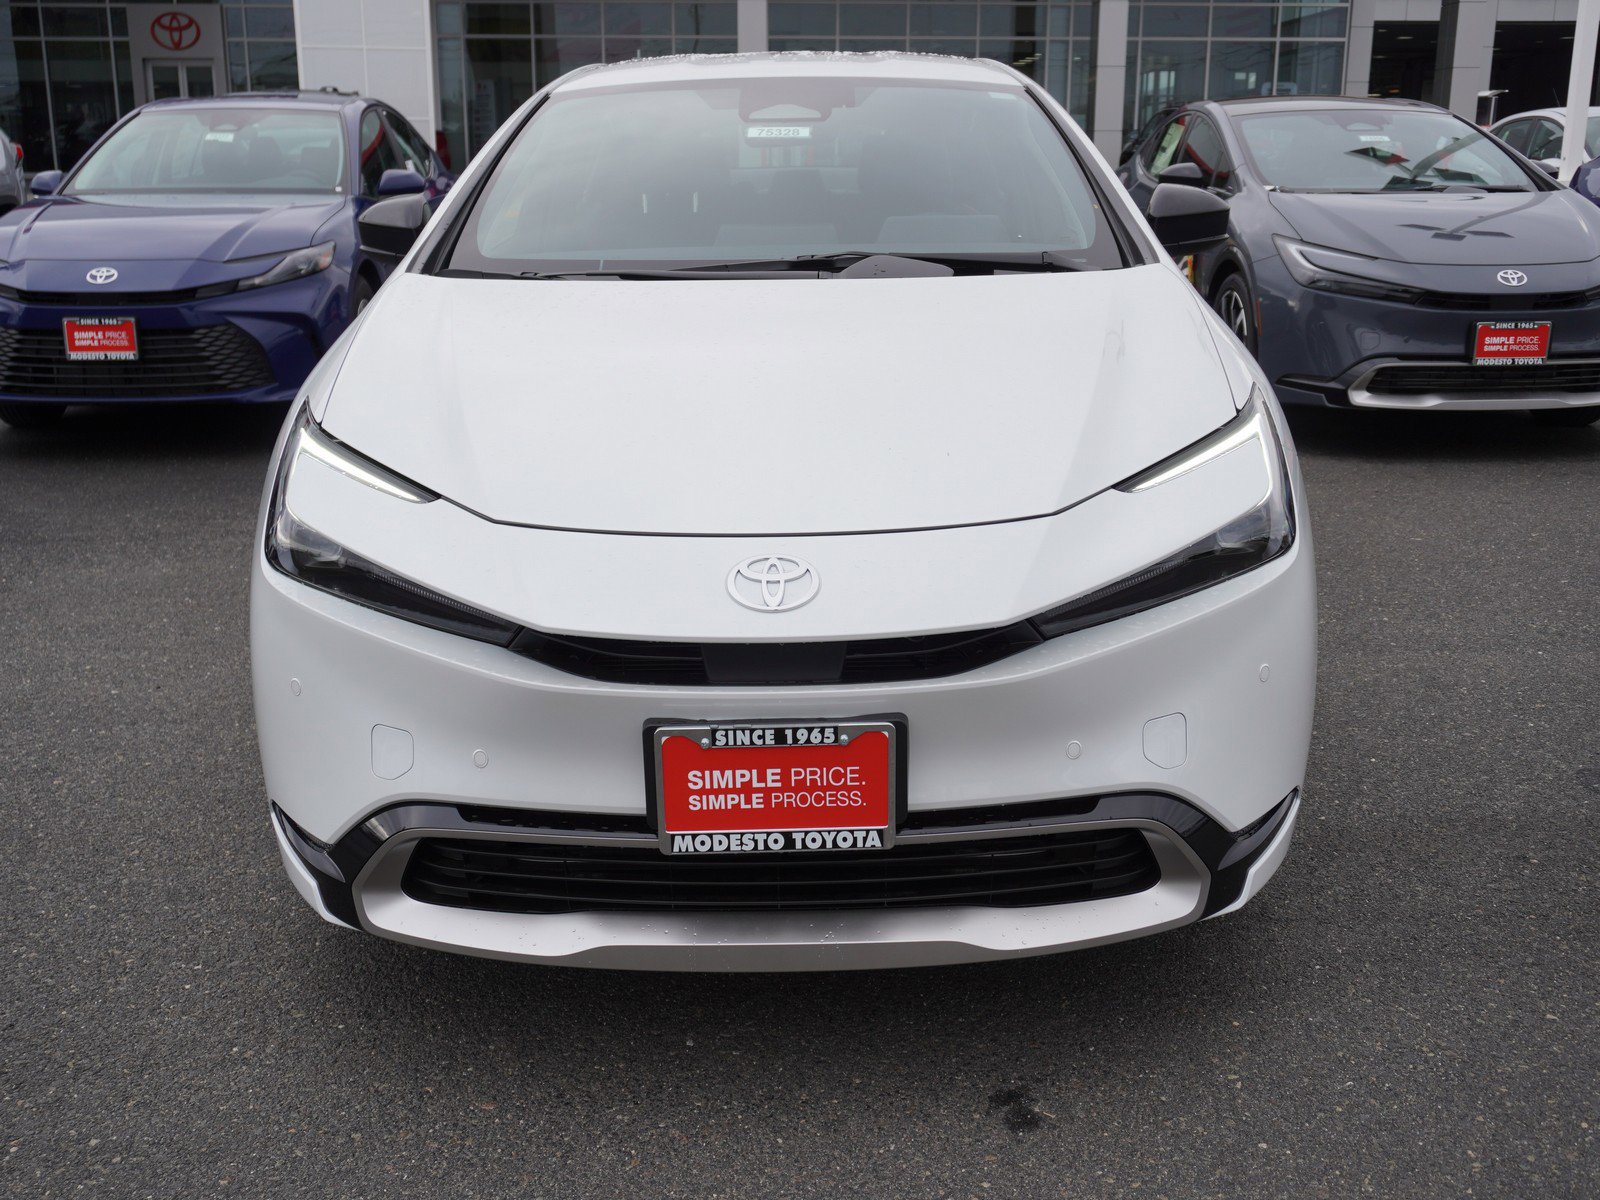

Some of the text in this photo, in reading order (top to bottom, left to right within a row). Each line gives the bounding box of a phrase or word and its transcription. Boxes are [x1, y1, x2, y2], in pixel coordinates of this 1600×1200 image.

[756, 128, 800, 136] 75328
[74, 331, 103, 339] SIMPLE
[1517, 336, 1541, 344] PRICE.
[715, 728, 836, 746] SINCE 1965
[687, 766, 866, 790] SIMPLE PRICE.
[688, 791, 867, 811] SIMPLE PROCESS.
[673, 830, 883, 853] MODESTO TOYOTA
